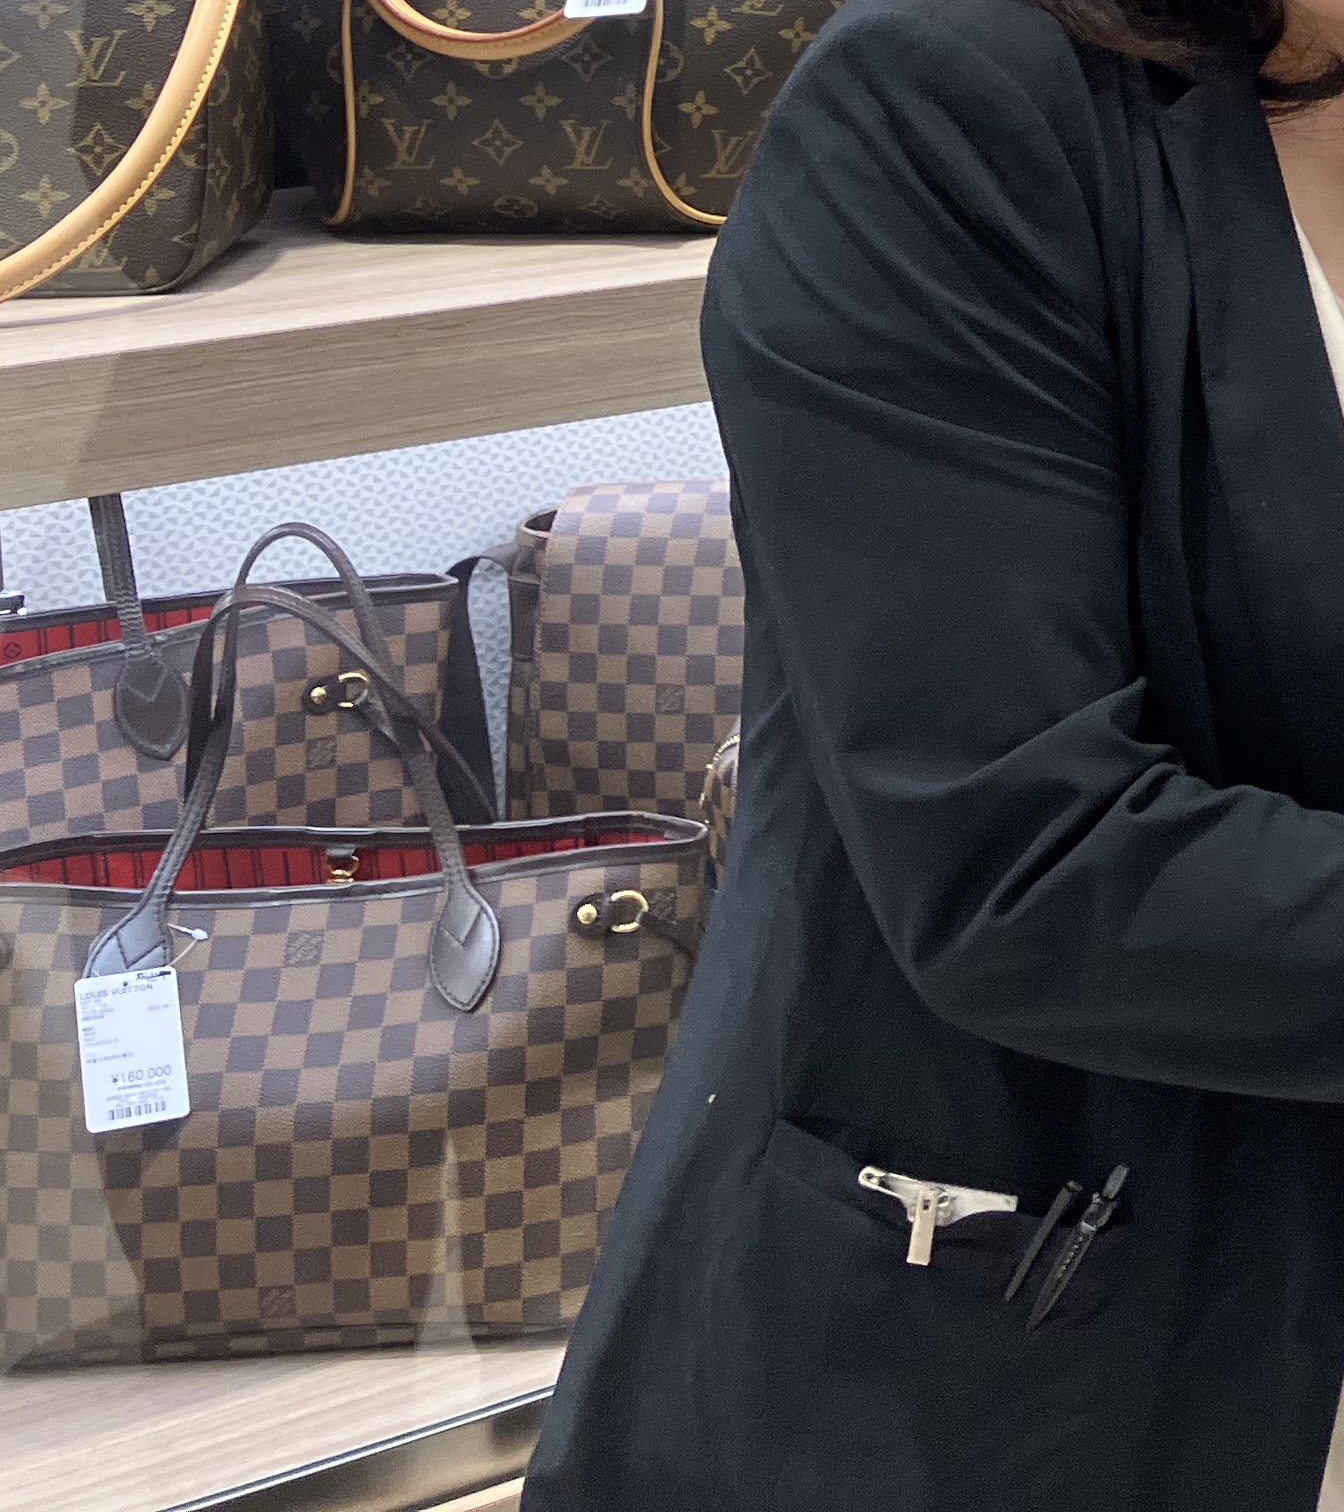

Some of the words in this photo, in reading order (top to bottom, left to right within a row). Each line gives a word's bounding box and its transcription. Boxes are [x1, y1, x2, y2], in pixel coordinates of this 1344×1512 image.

[80, 990, 108, 1001] LOUIS
[111, 983, 153, 995] VUITTON
[111, 1064, 173, 1083] ¥160,000
